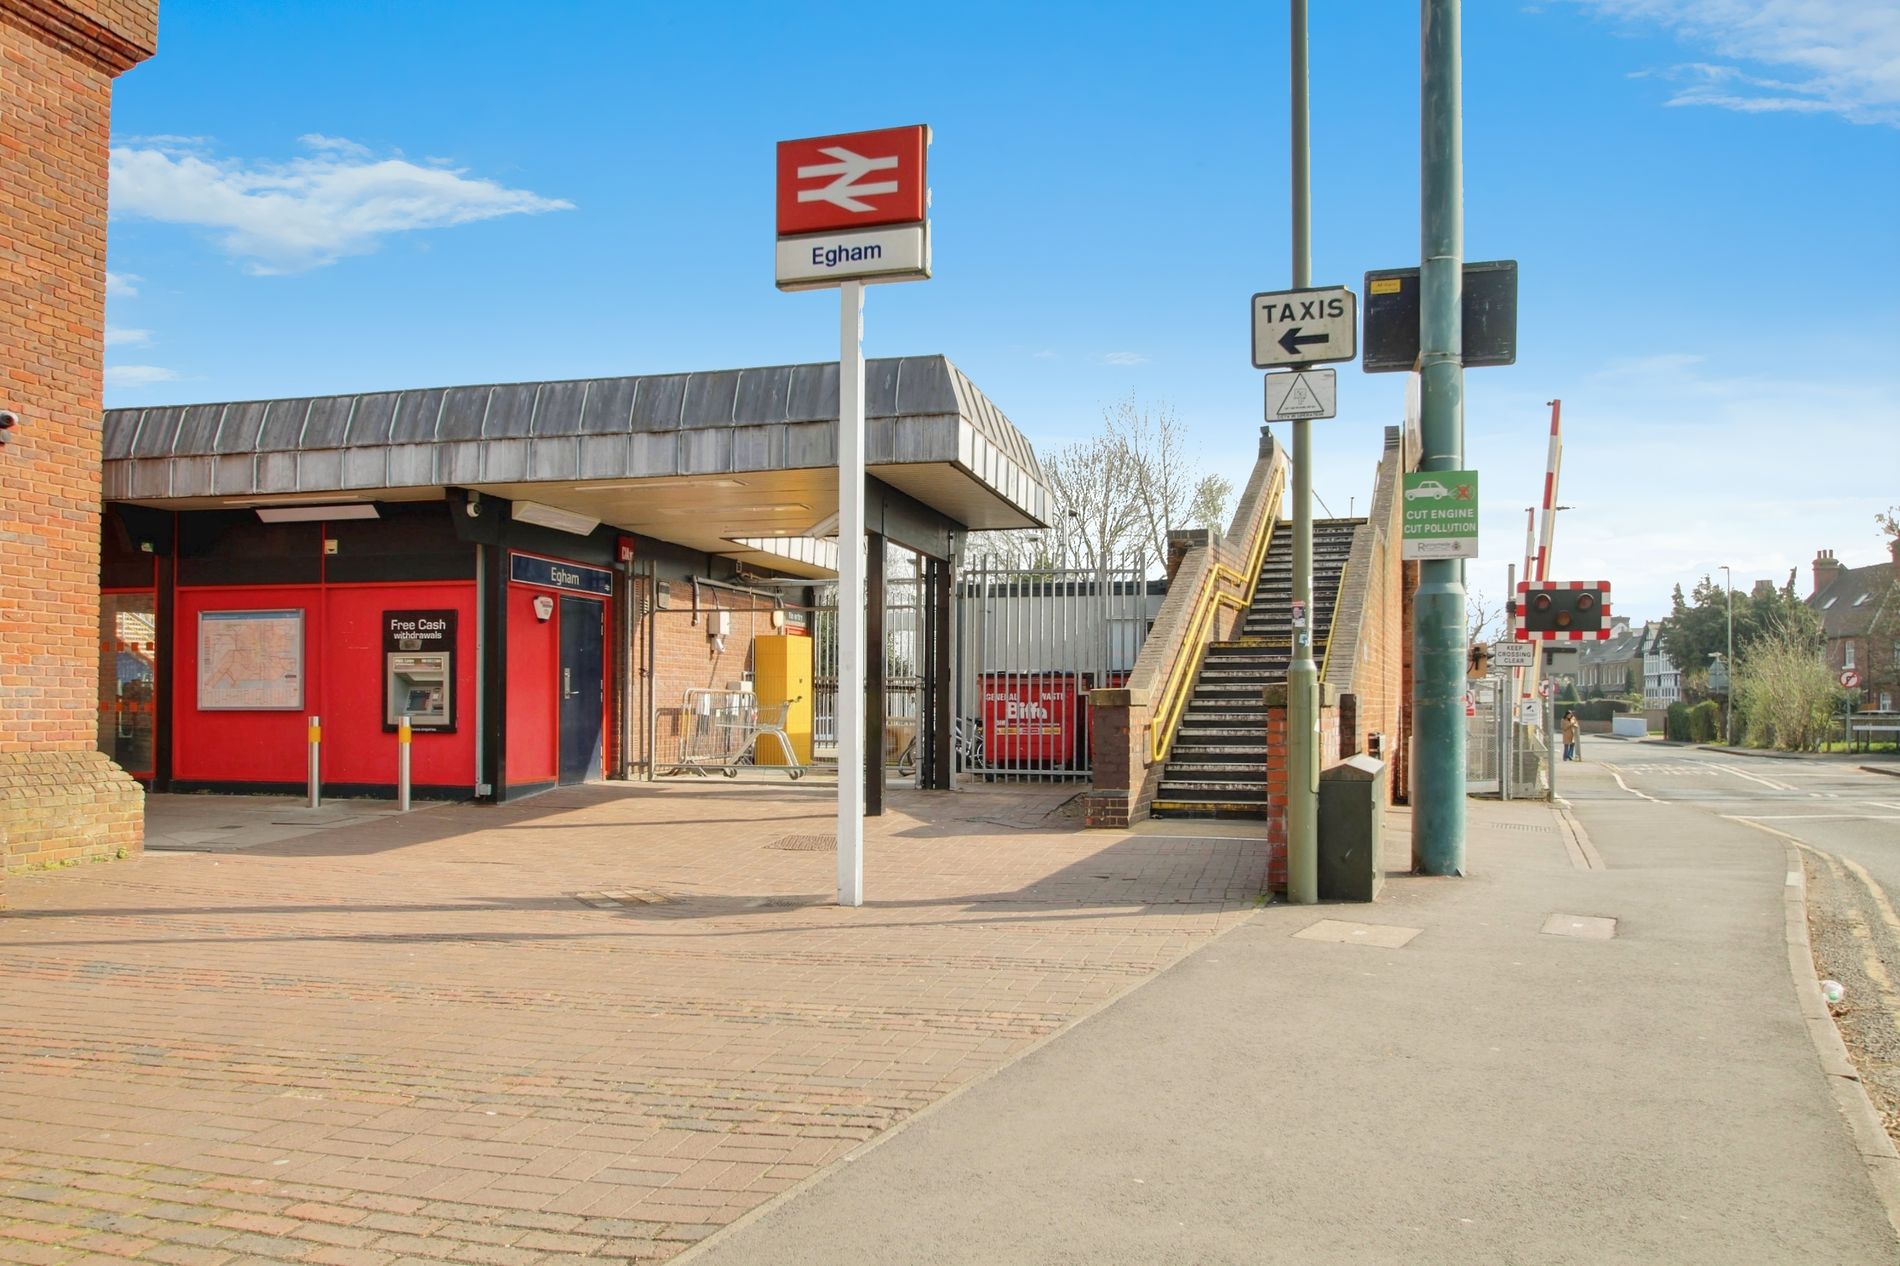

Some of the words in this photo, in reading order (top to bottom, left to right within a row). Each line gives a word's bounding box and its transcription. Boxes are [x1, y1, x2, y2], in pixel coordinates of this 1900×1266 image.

[812, 243, 882, 267] Egham
[1262, 297, 1344, 324] TAXIS
[1406, 510, 1428, 520] CUT
[1431, 508, 1474, 519] ENGINE
[1404, 524, 1422, 534] CUT
[1425, 522, 1476, 533] POLLUTION
[551, 567, 580, 586] Egham
[391, 619, 416, 631] Free
[418, 618, 446, 631] Cash
[393, 631, 442, 640] withdrawals
[1007, 701, 1048, 720] Biffa
